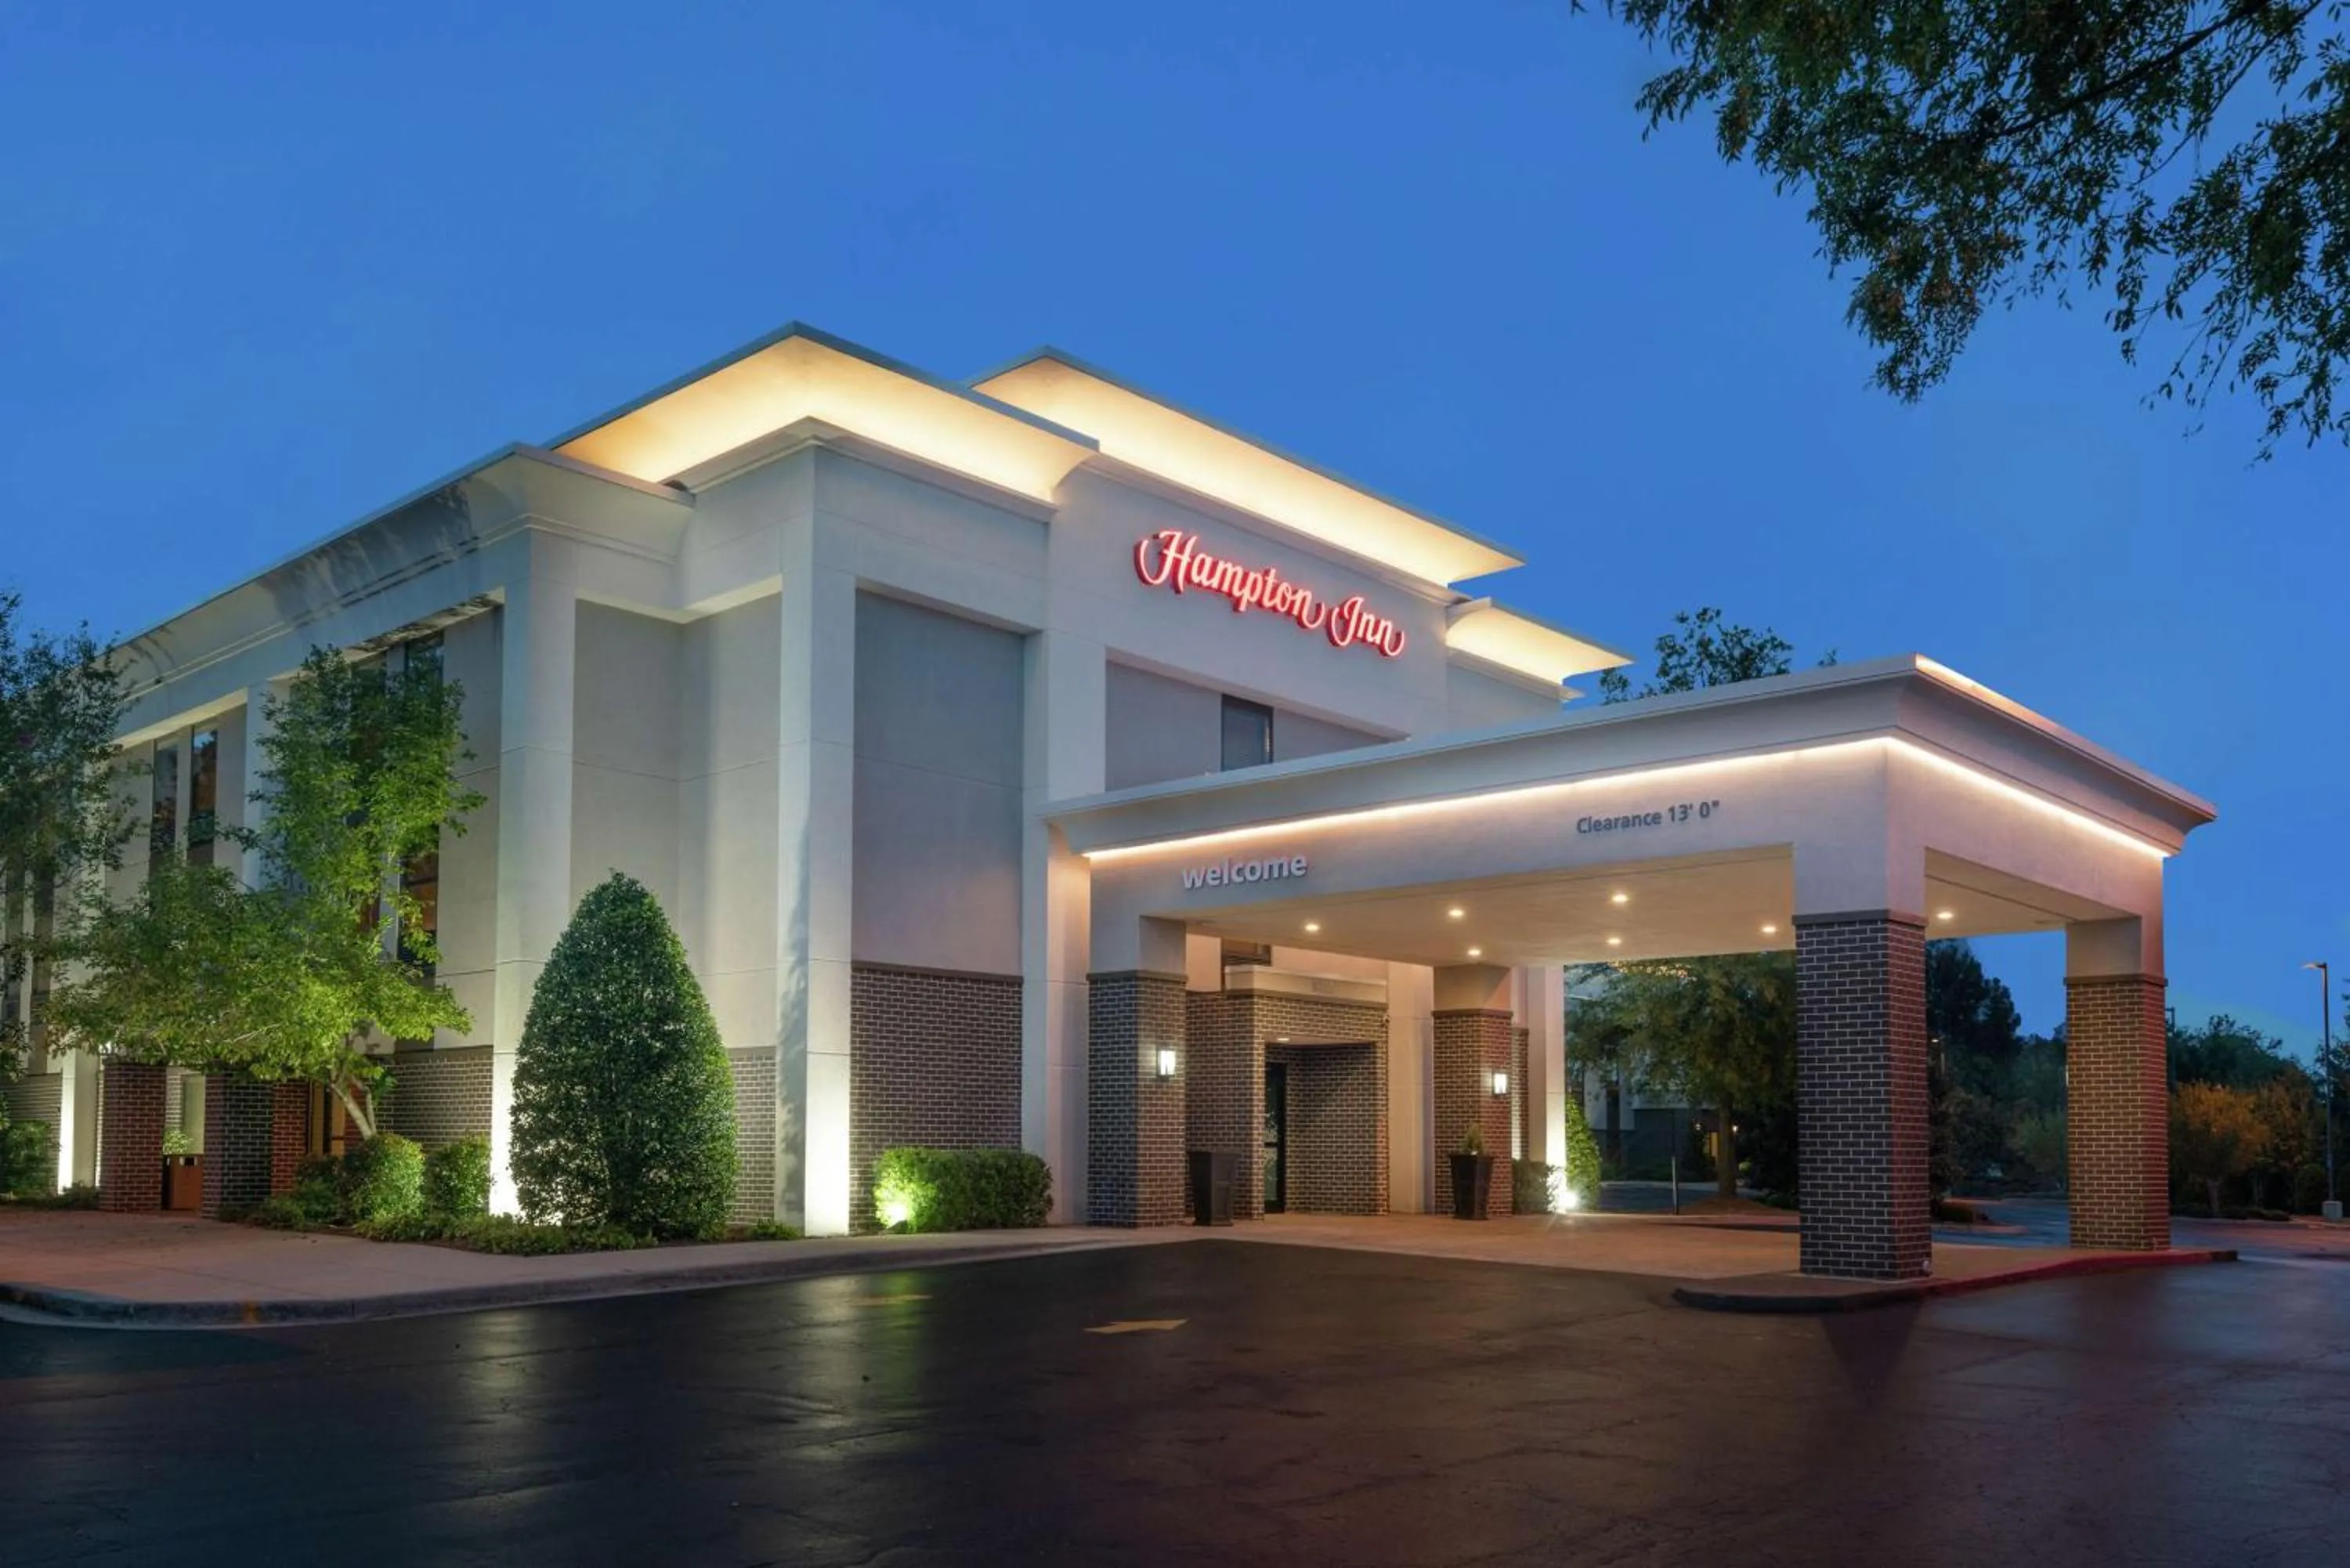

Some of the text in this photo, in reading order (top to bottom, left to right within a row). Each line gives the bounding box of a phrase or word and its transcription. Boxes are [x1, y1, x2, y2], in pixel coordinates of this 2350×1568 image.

[1134, 529, 1405, 656] Hampton Inn
[1576, 800, 1720, 833] Clearance 13' 0"
[1183, 854, 1307, 890] welcome
